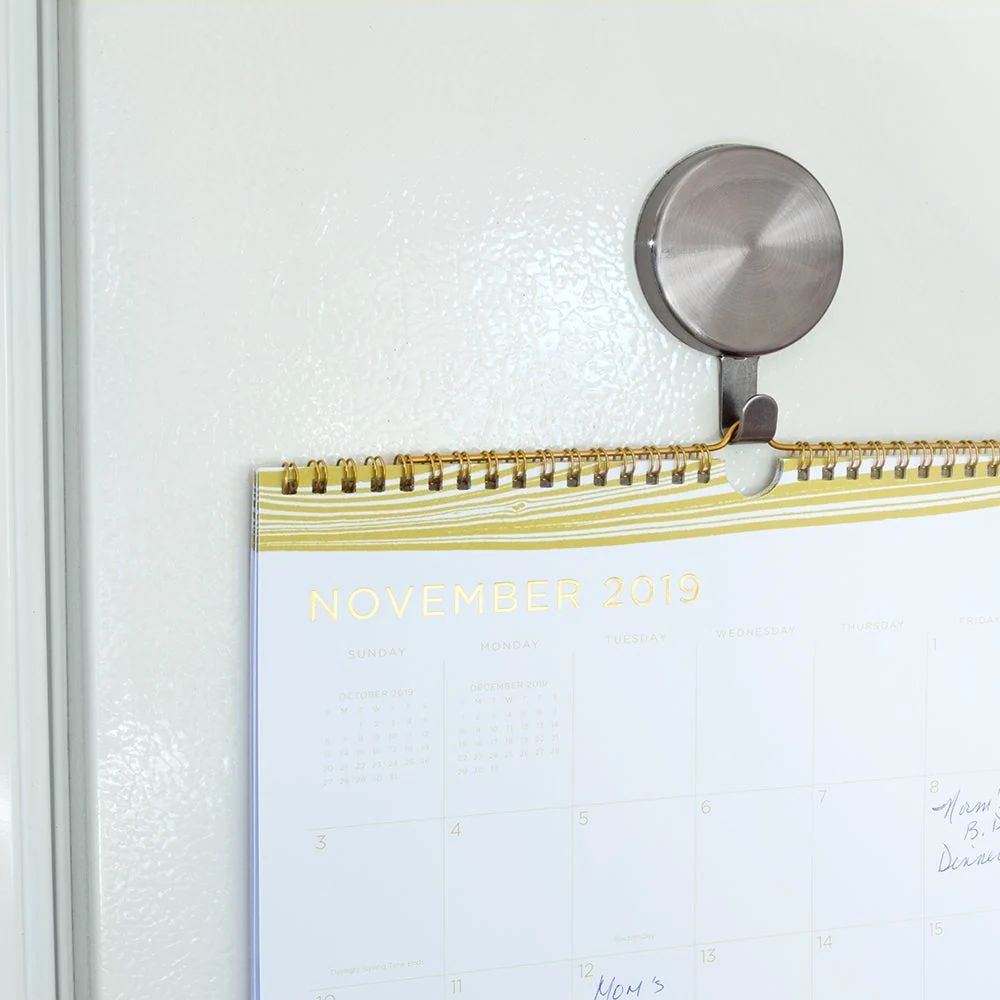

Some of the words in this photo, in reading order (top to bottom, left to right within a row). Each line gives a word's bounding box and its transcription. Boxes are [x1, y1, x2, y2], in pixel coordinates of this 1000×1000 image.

[310, 578, 581, 623] NOVEMBER
[602, 572, 700, 609] 2019
[348, 647, 406, 660] SUNDAY
[480, 639, 540, 652] MONDAY
[606, 632, 667, 645] TUESDAY
[716, 625, 796, 639] WEDNESDAY
[841, 619, 904, 632] THURSDAY
[959, 614, 1000, 625] FRIDAY
[314, 834, 327, 851] 3
[449, 821, 463, 837] 4
[578, 810, 589, 827] 5
[700, 799, 713, 815] 6
[817, 788, 828, 804] 7
[929, 779, 940, 794] 8
[449, 977, 463, 995] 11
[577, 962, 595, 979] 12
[700, 947, 717, 964] 13
[817, 935, 833, 950] 14
[929, 921, 944, 937] 15
